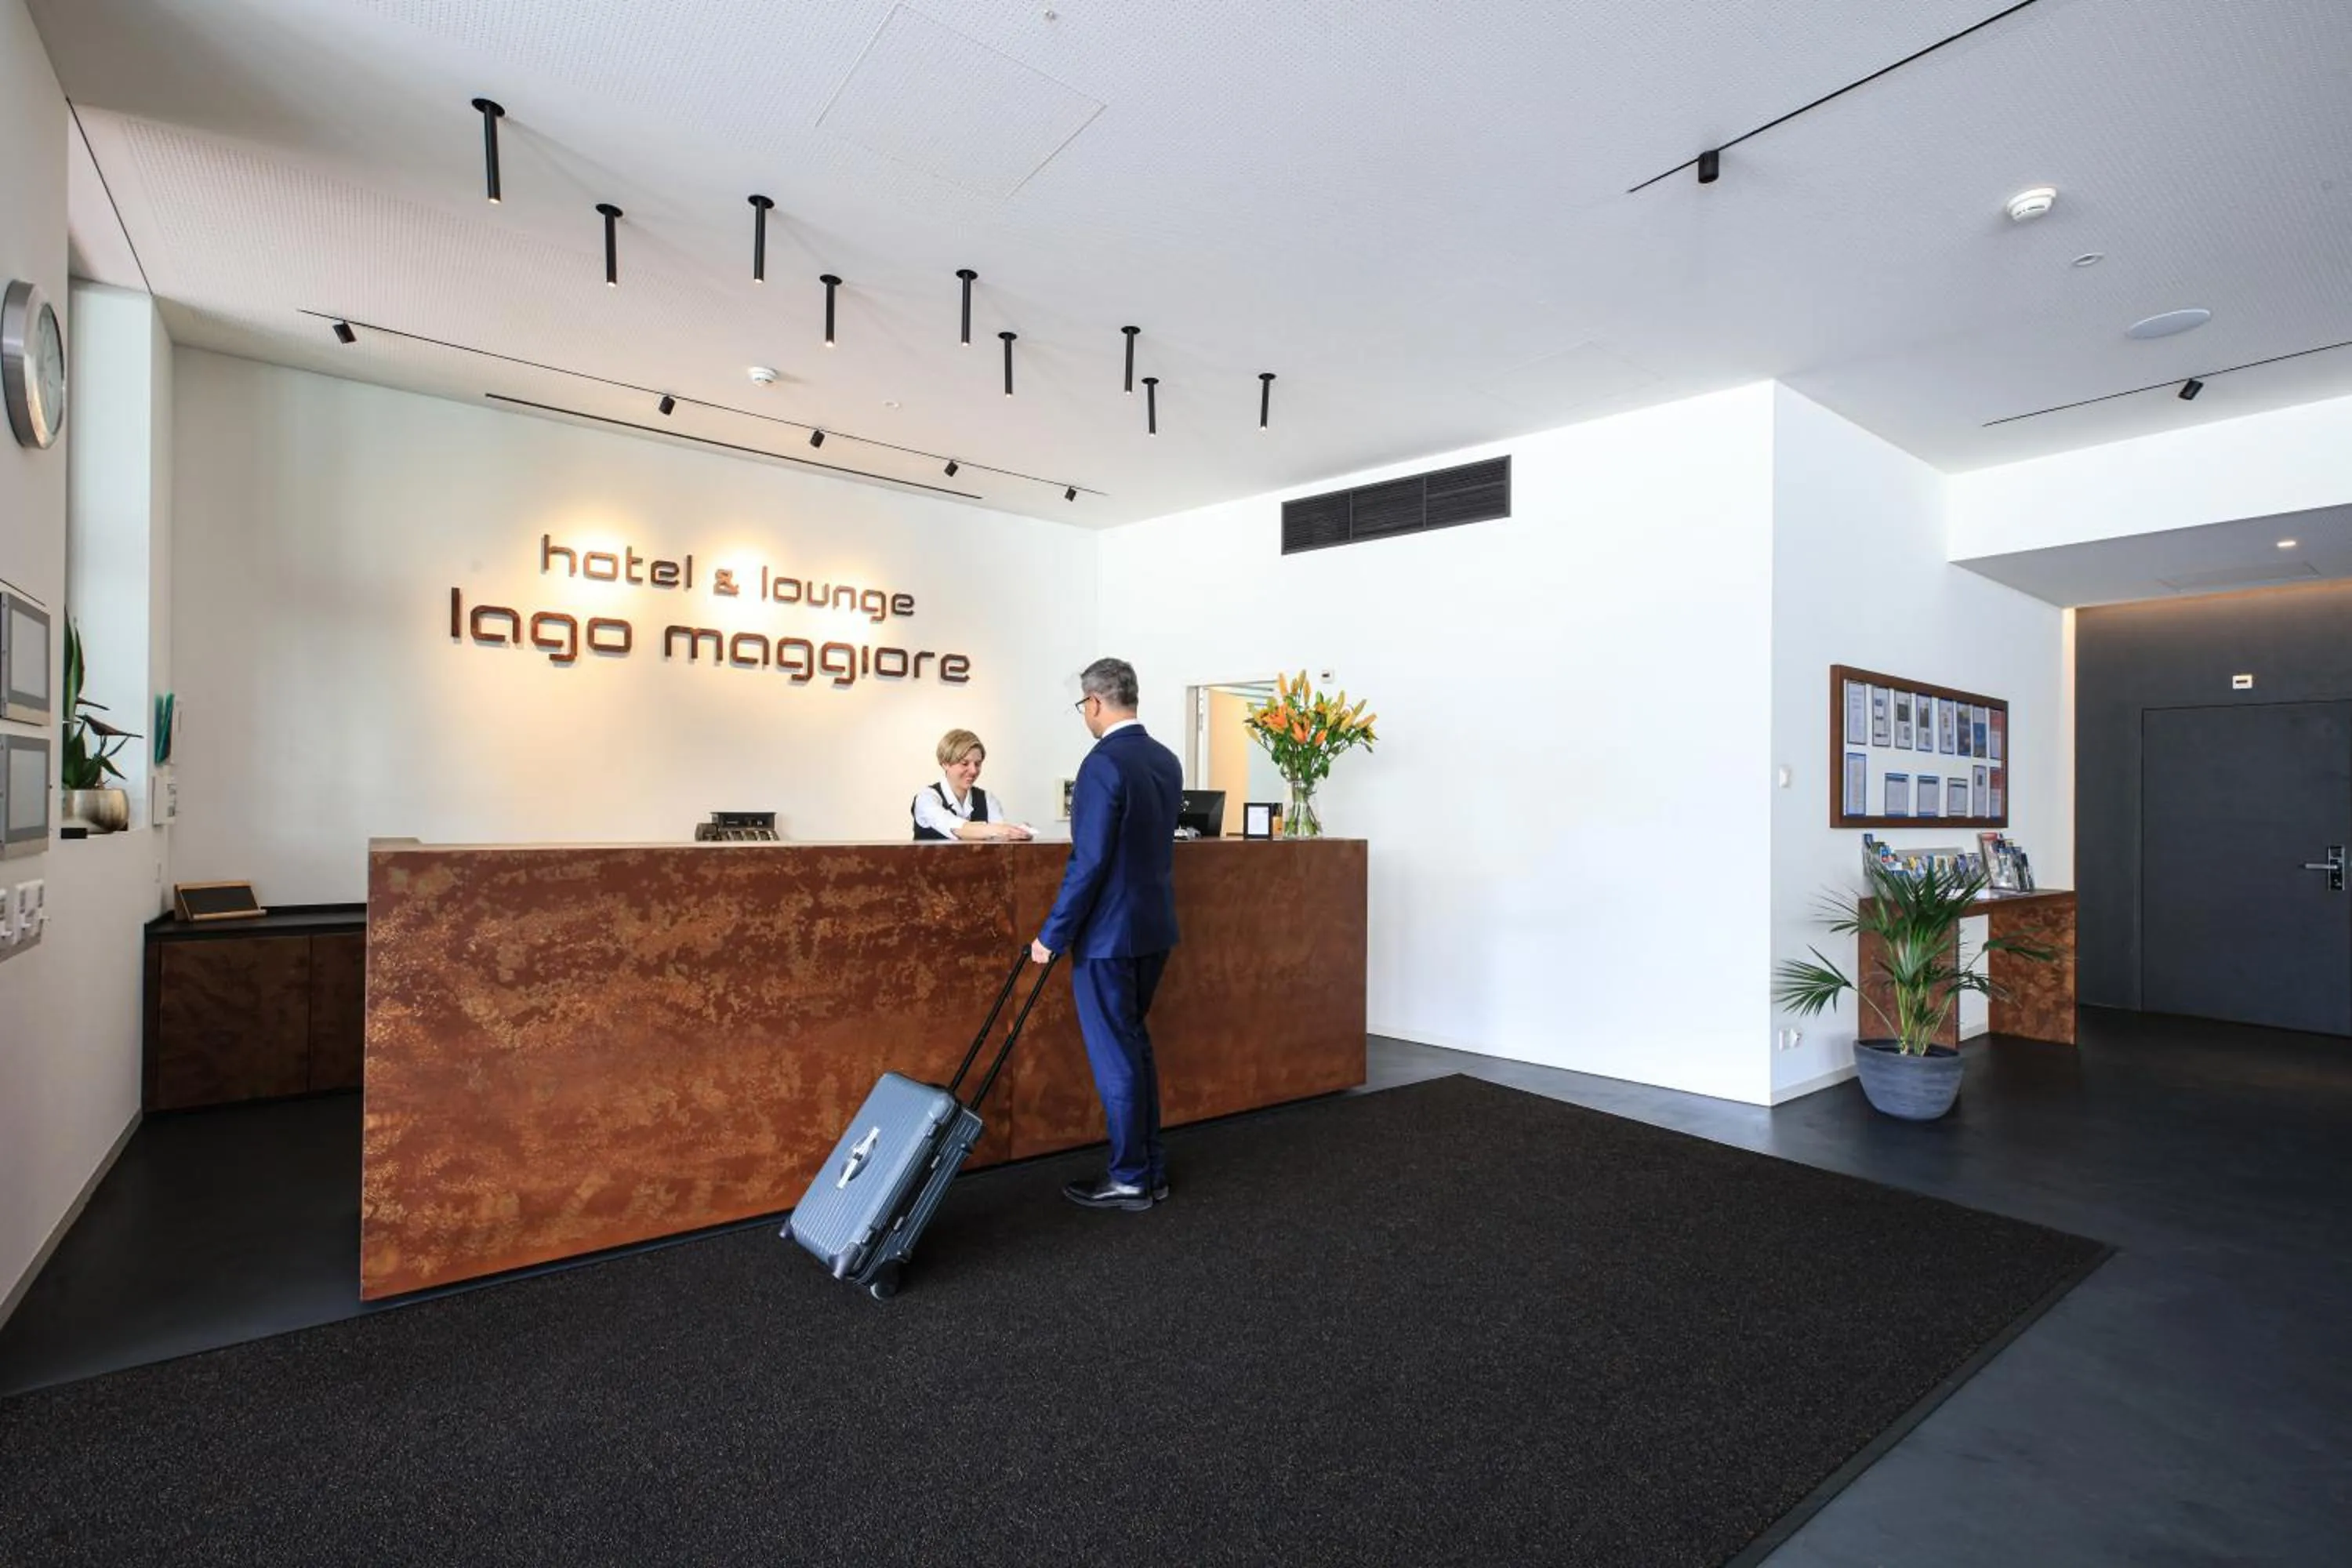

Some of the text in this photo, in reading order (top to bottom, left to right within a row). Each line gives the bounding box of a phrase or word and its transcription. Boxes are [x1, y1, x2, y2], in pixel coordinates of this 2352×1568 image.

[541, 533, 915, 622] hotel & lounge
[449, 586, 971, 686] lago maggiore
